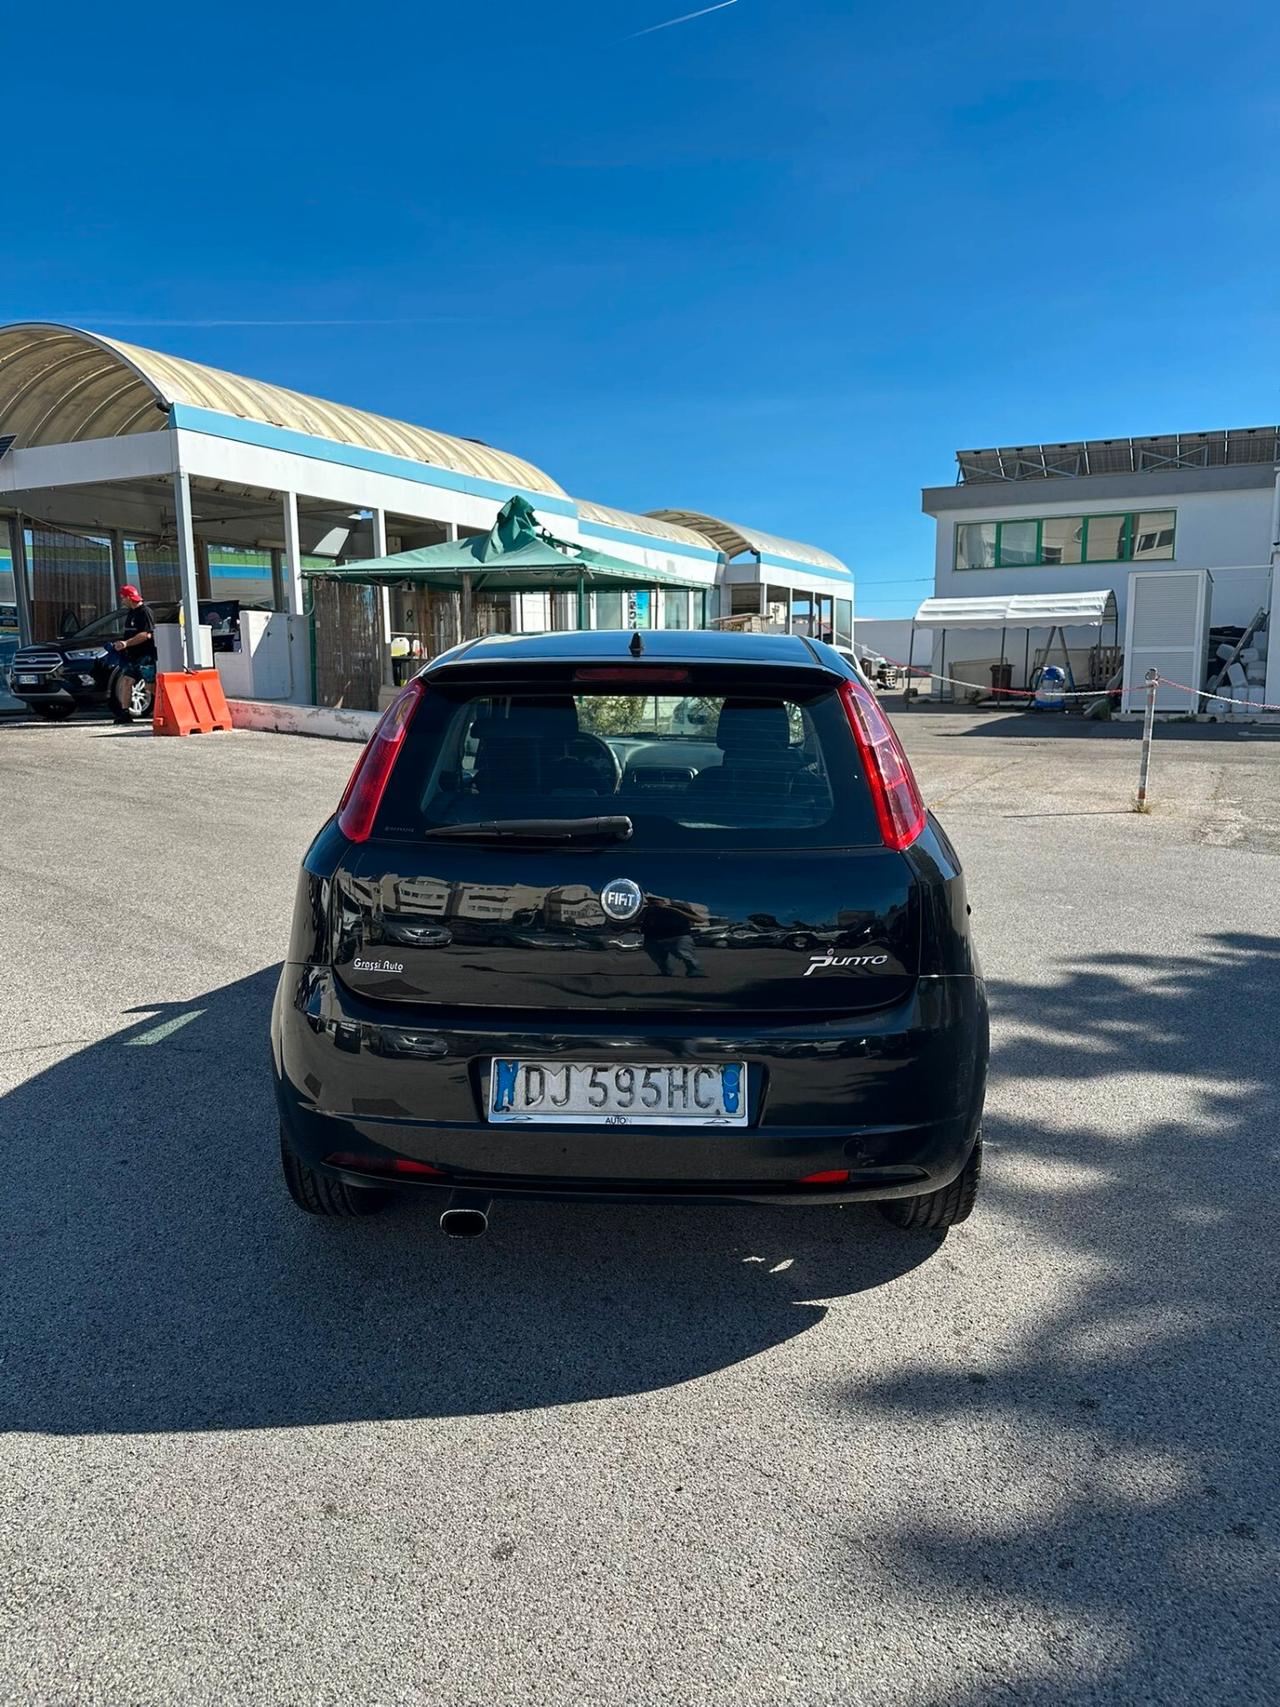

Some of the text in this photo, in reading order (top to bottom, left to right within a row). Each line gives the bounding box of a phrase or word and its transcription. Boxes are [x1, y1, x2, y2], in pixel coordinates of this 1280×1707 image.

[608, 891, 635, 906] FIAT
[383, 960, 404, 972] Auto
[524, 1065, 715, 1109] DJ 595HC
